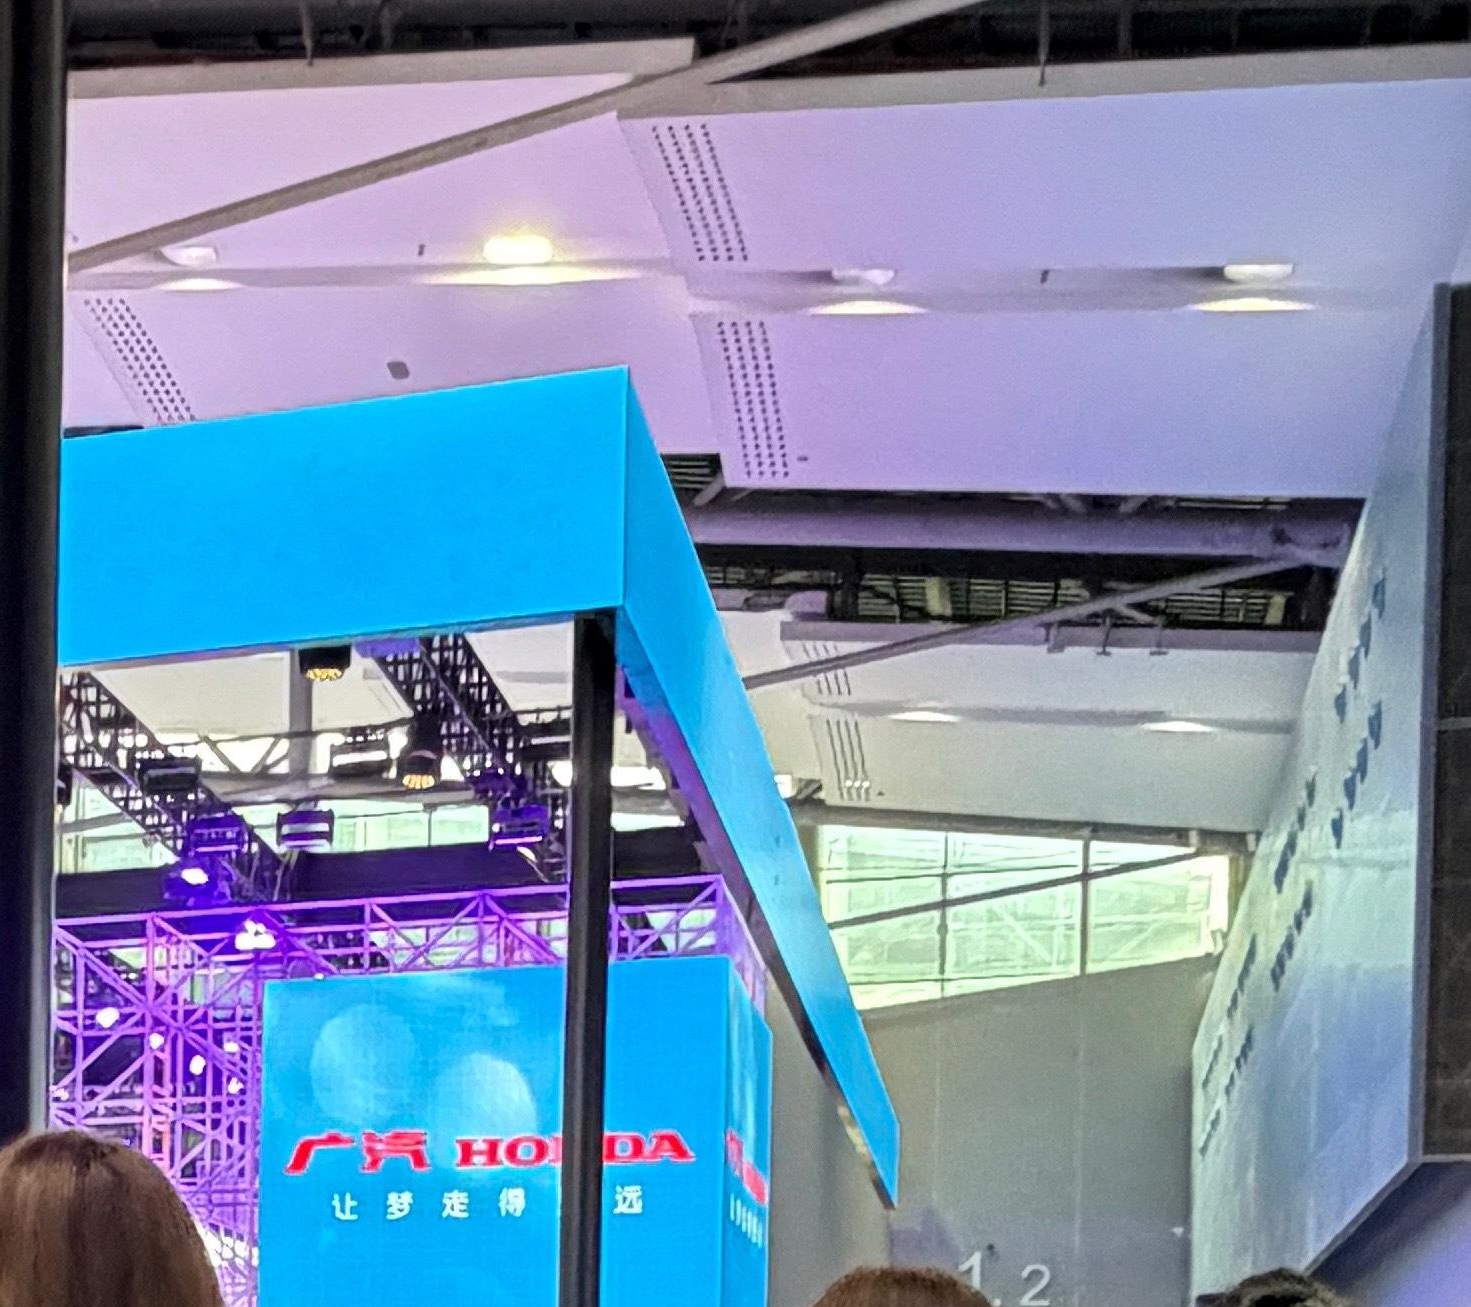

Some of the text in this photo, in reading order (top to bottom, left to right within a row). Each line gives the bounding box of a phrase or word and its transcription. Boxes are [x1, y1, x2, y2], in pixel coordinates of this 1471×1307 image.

[285, 1132, 431, 1175] 广汽
[332, 1186, 643, 1220] 让梦走得远
